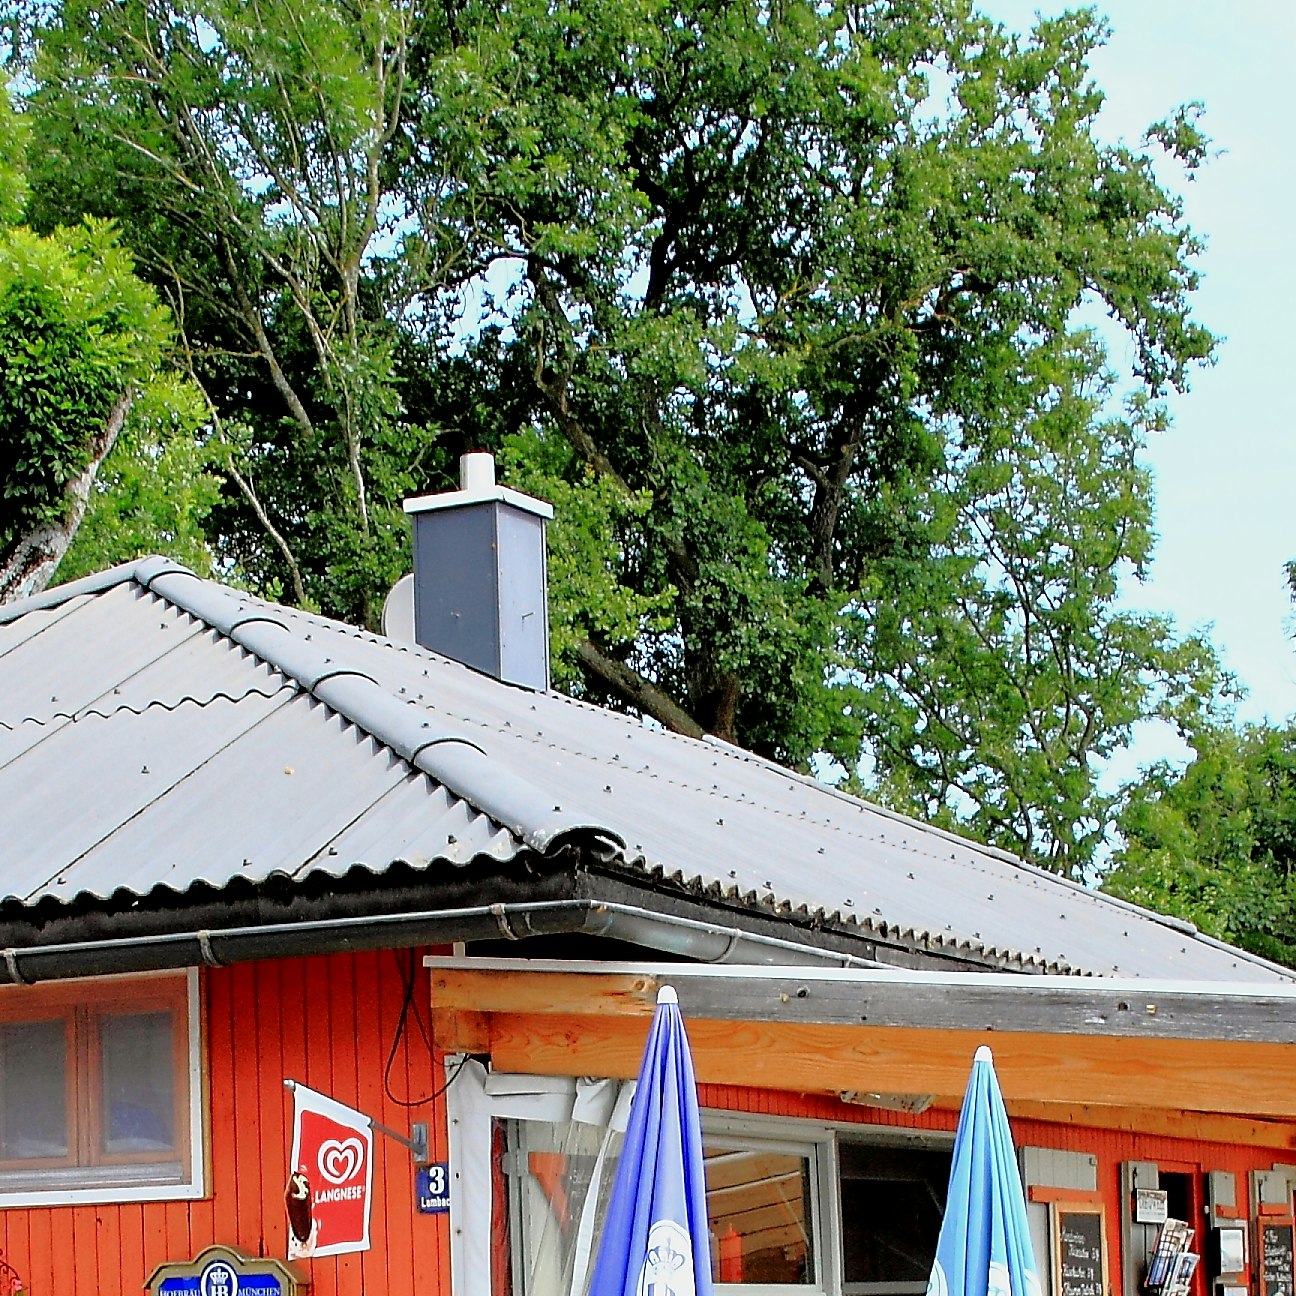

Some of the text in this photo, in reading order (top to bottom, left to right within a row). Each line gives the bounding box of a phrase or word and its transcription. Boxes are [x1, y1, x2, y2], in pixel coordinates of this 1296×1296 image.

[429, 1166, 445, 1194] 3
[314, 1186, 362, 1204] LANGNESE
[421, 1196, 450, 1208] Lambac
